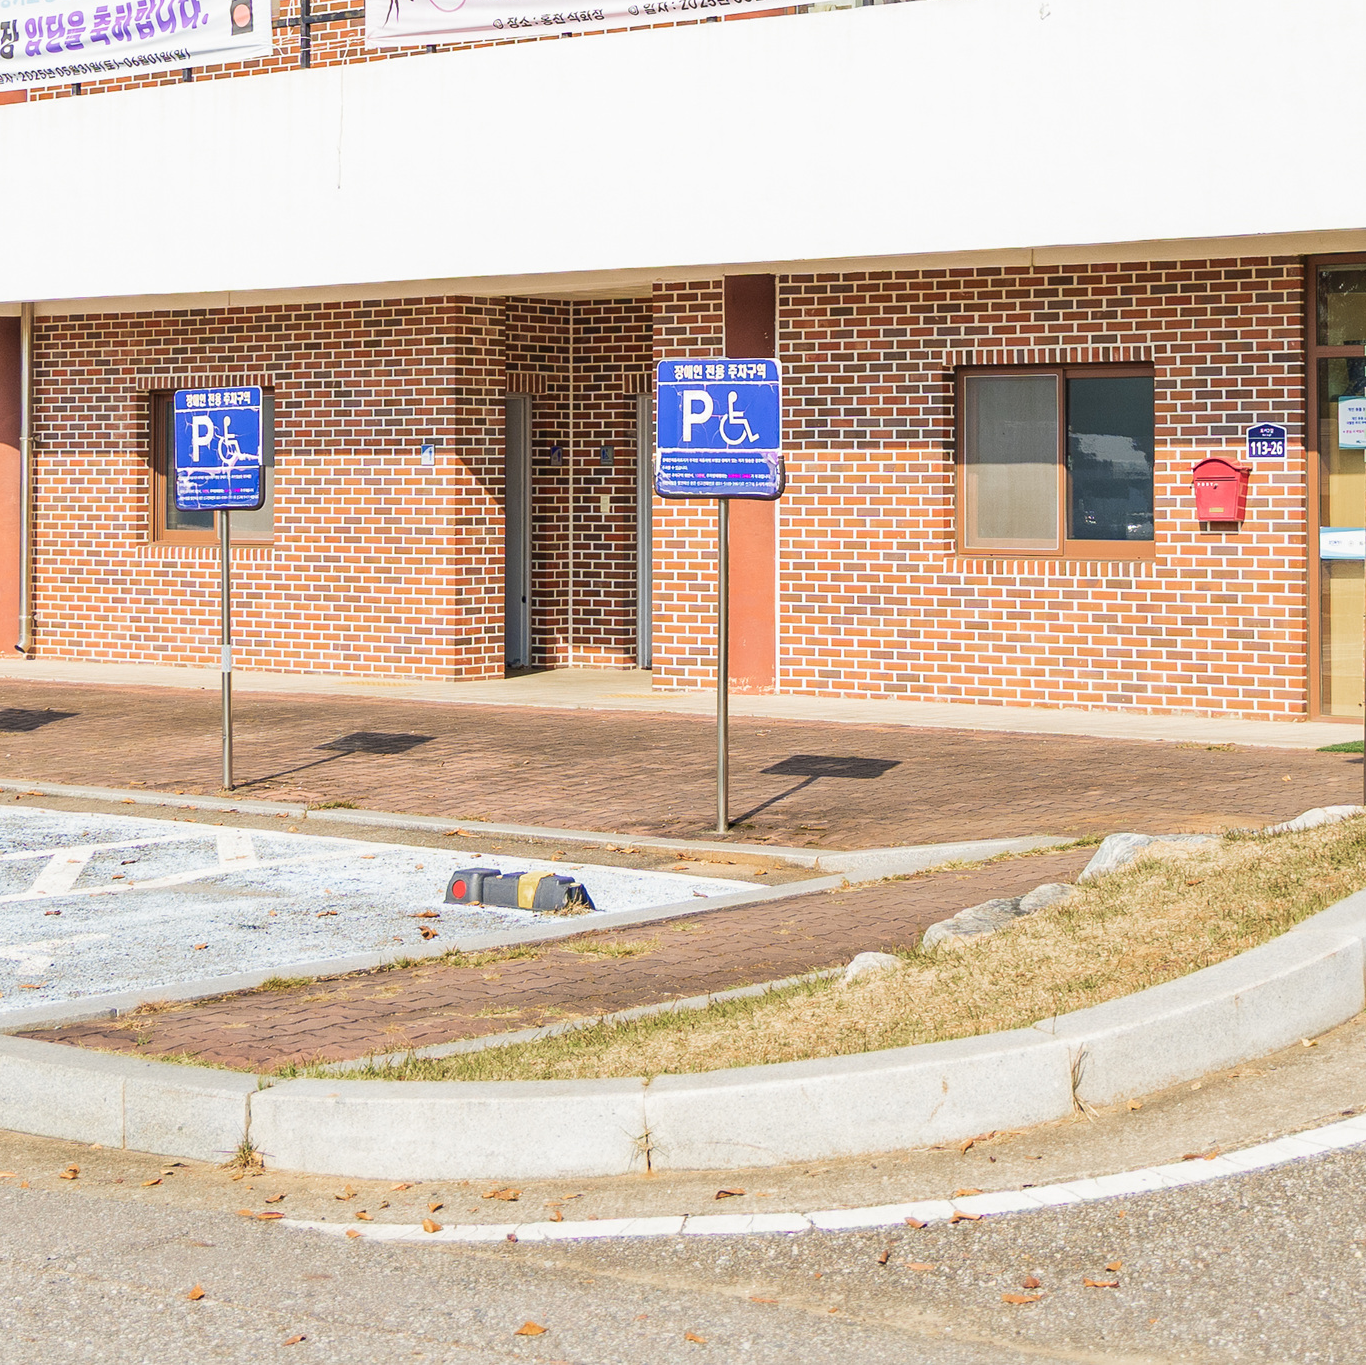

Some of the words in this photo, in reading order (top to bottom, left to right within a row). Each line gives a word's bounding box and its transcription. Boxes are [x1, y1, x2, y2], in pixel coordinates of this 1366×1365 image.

[643, 1, 670, 15] 일자
[25, 10, 86, 58] 입단을
[674, 364, 703, 380] 장애인
[705, 364, 725, 379] 전용
[727, 363, 767, 379] 주차구역
[683, 390, 714, 442] P
[192, 415, 214, 463] P
[1250, 441, 1283, 456] 113-26
